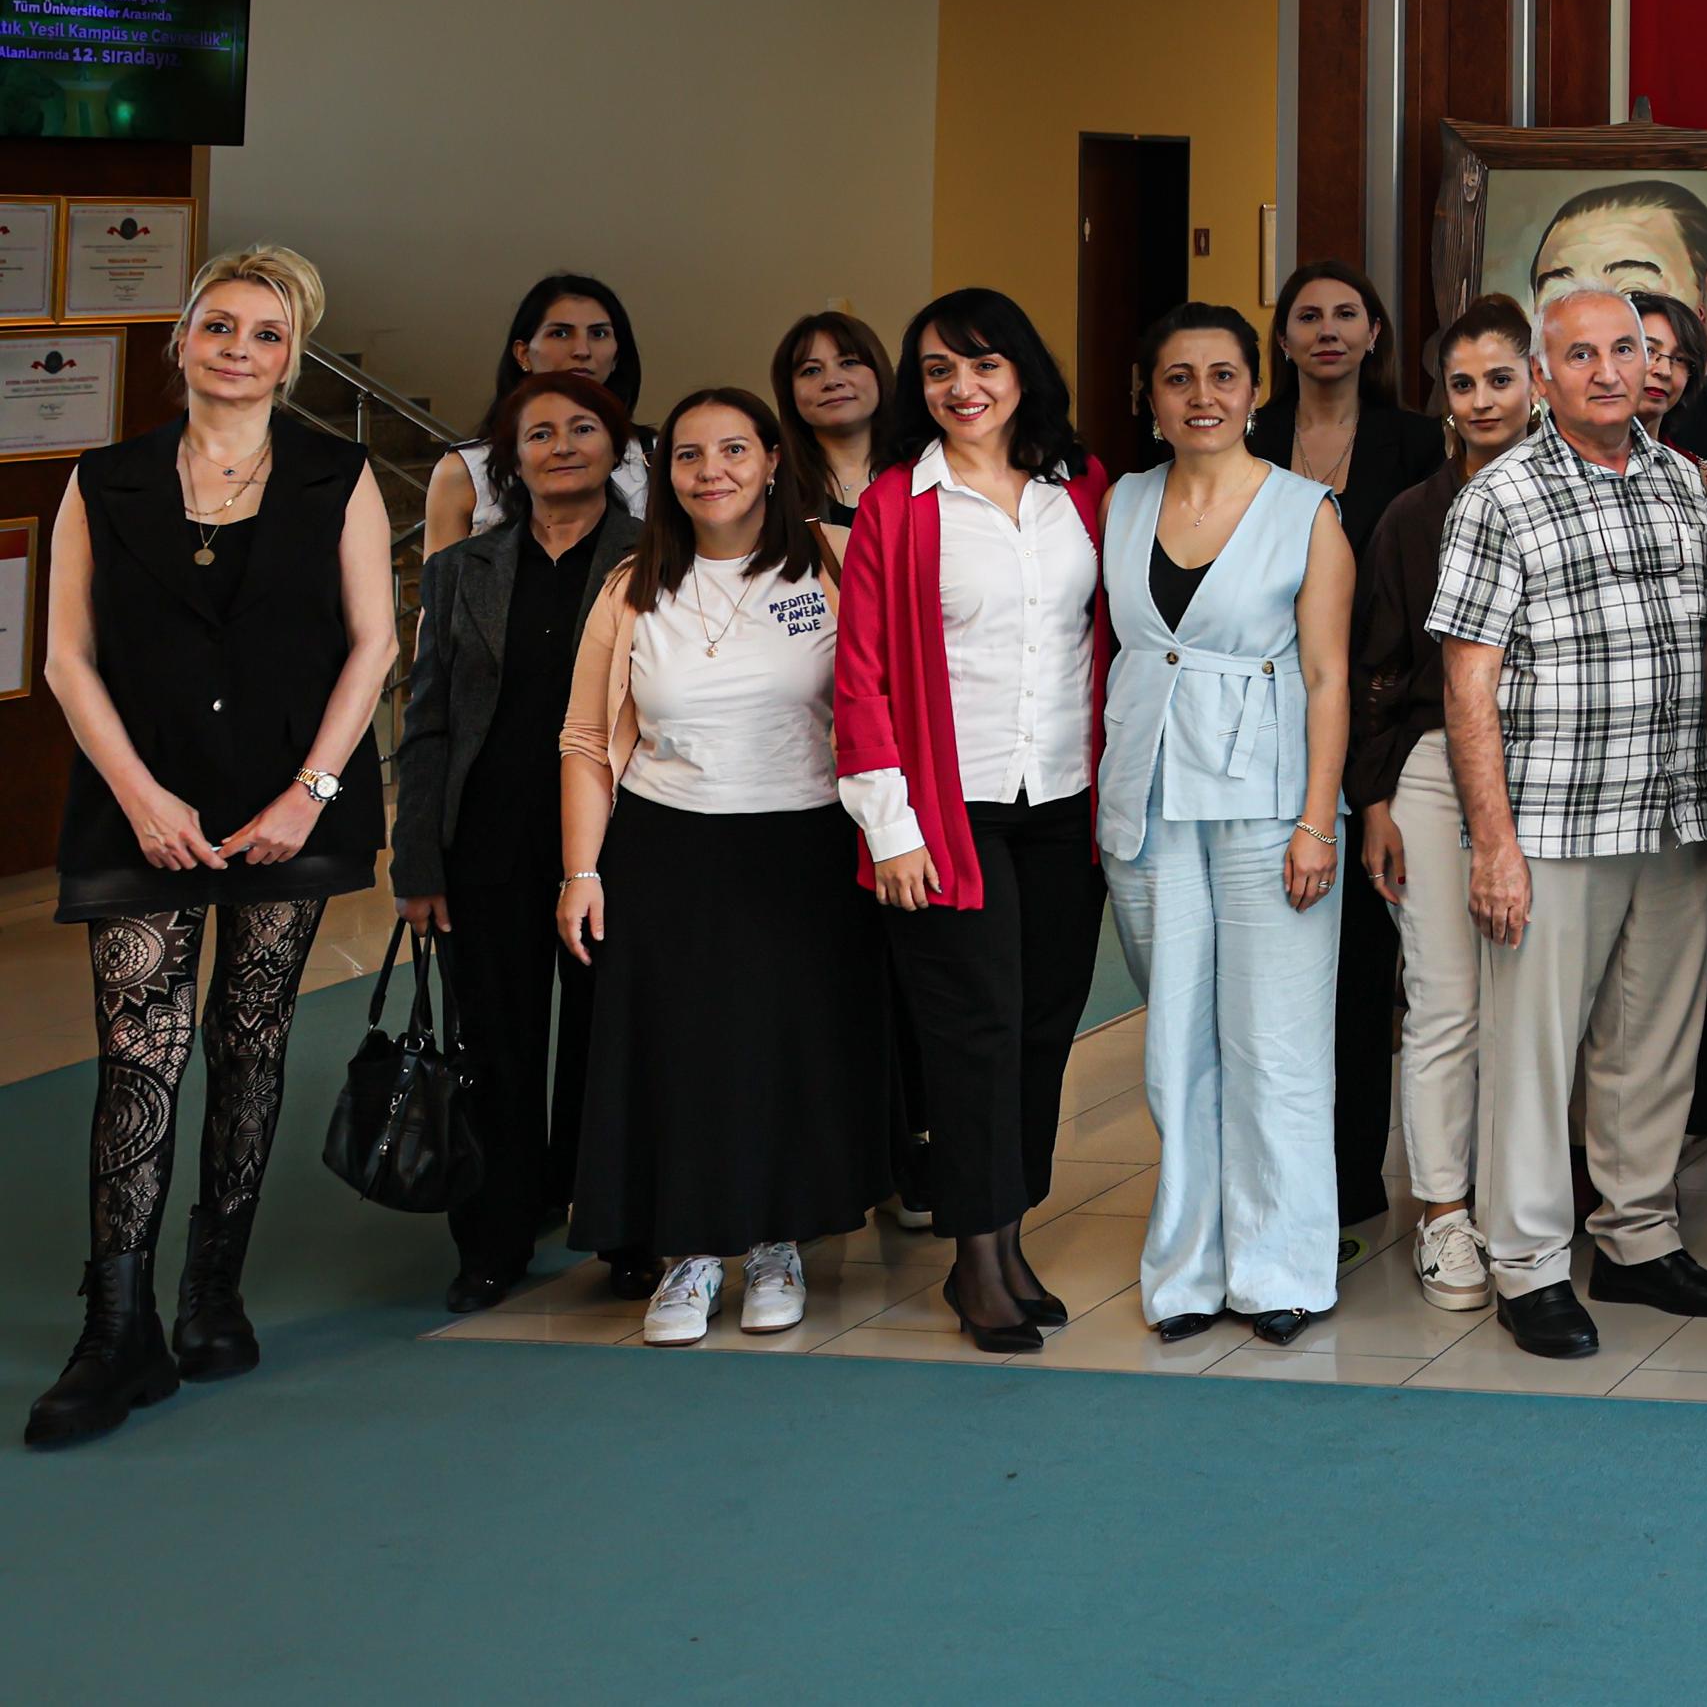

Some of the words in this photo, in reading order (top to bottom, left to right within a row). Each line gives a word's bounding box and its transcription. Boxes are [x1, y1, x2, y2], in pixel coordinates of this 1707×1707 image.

[13, 0, 40, 14] Tüm
[0, 20, 25, 36] tık,
[68, 23, 129, 43] Kampüs
[131, 31, 148, 42] ve
[72, 47, 97, 62] 12.
[769, 592, 825, 614] MEDITER-
[787, 619, 821, 636] BLUE
